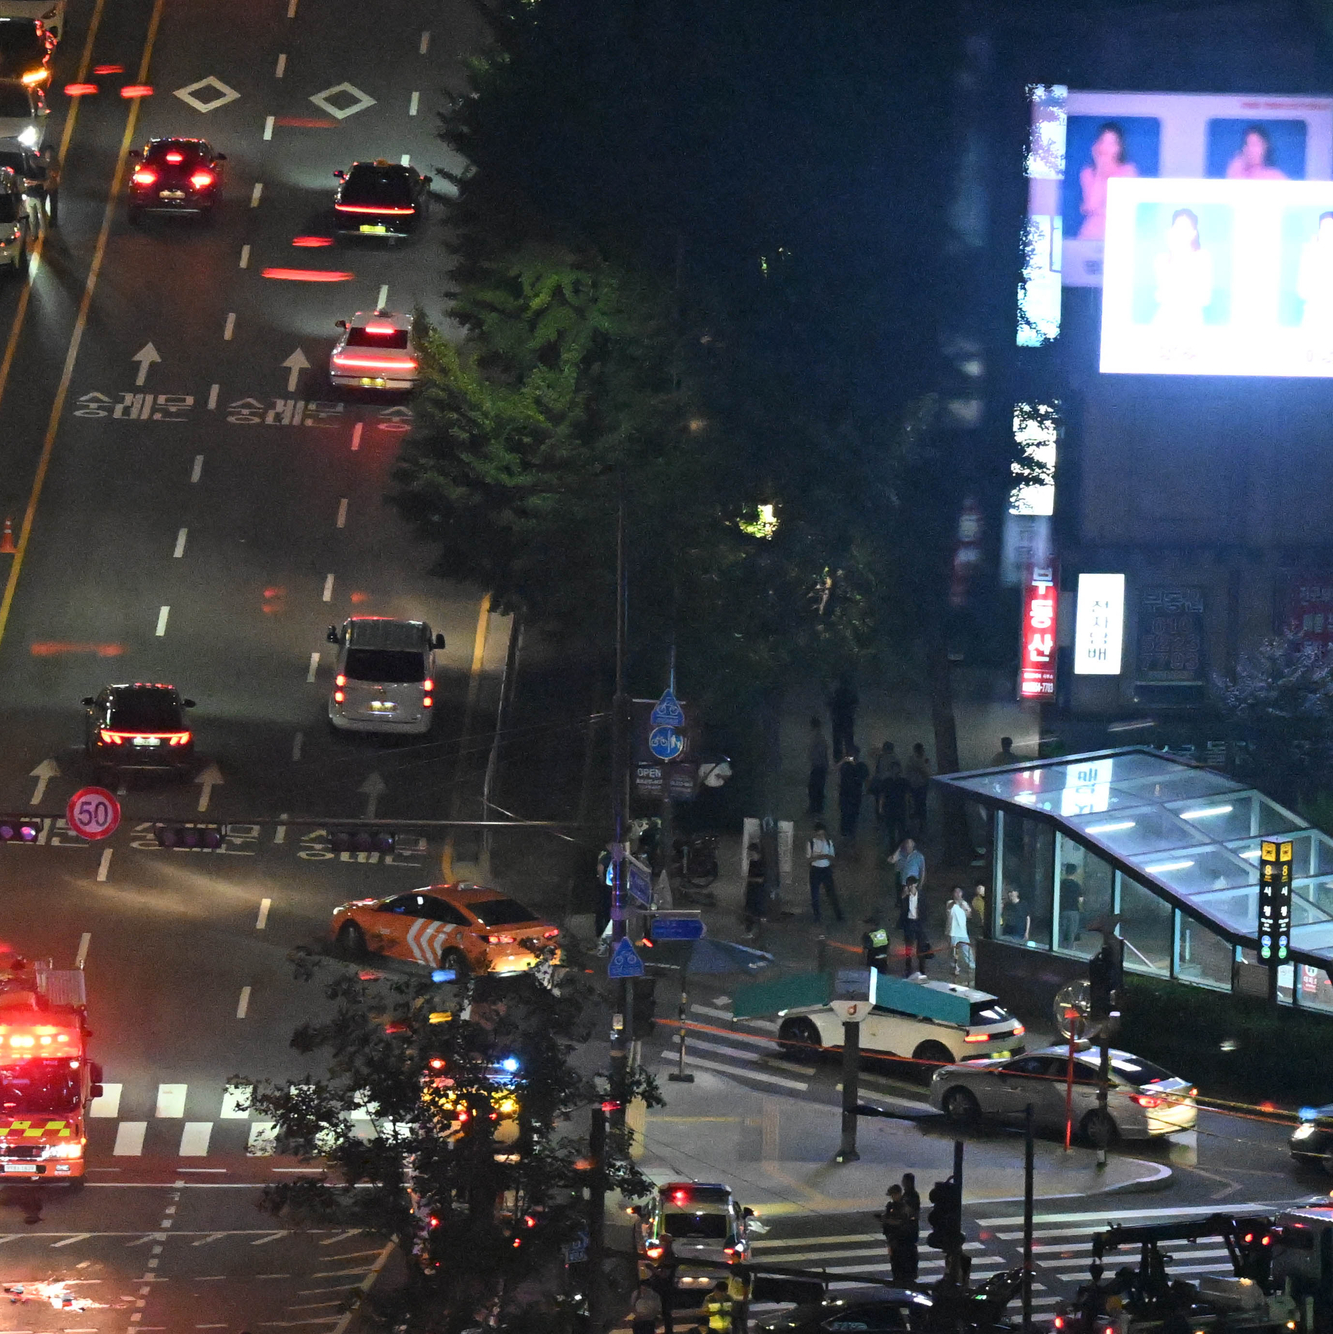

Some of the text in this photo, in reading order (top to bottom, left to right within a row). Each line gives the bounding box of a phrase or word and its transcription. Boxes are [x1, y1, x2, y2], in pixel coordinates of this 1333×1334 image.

[73, 391, 195, 422] 숭례문
[226, 398, 344, 428] 숭례문
[636, 767, 663, 779] OPEN
[77, 801, 109, 827] 50
[1264, 864, 1272, 875] 8
[1282, 864, 1289, 875] 8
